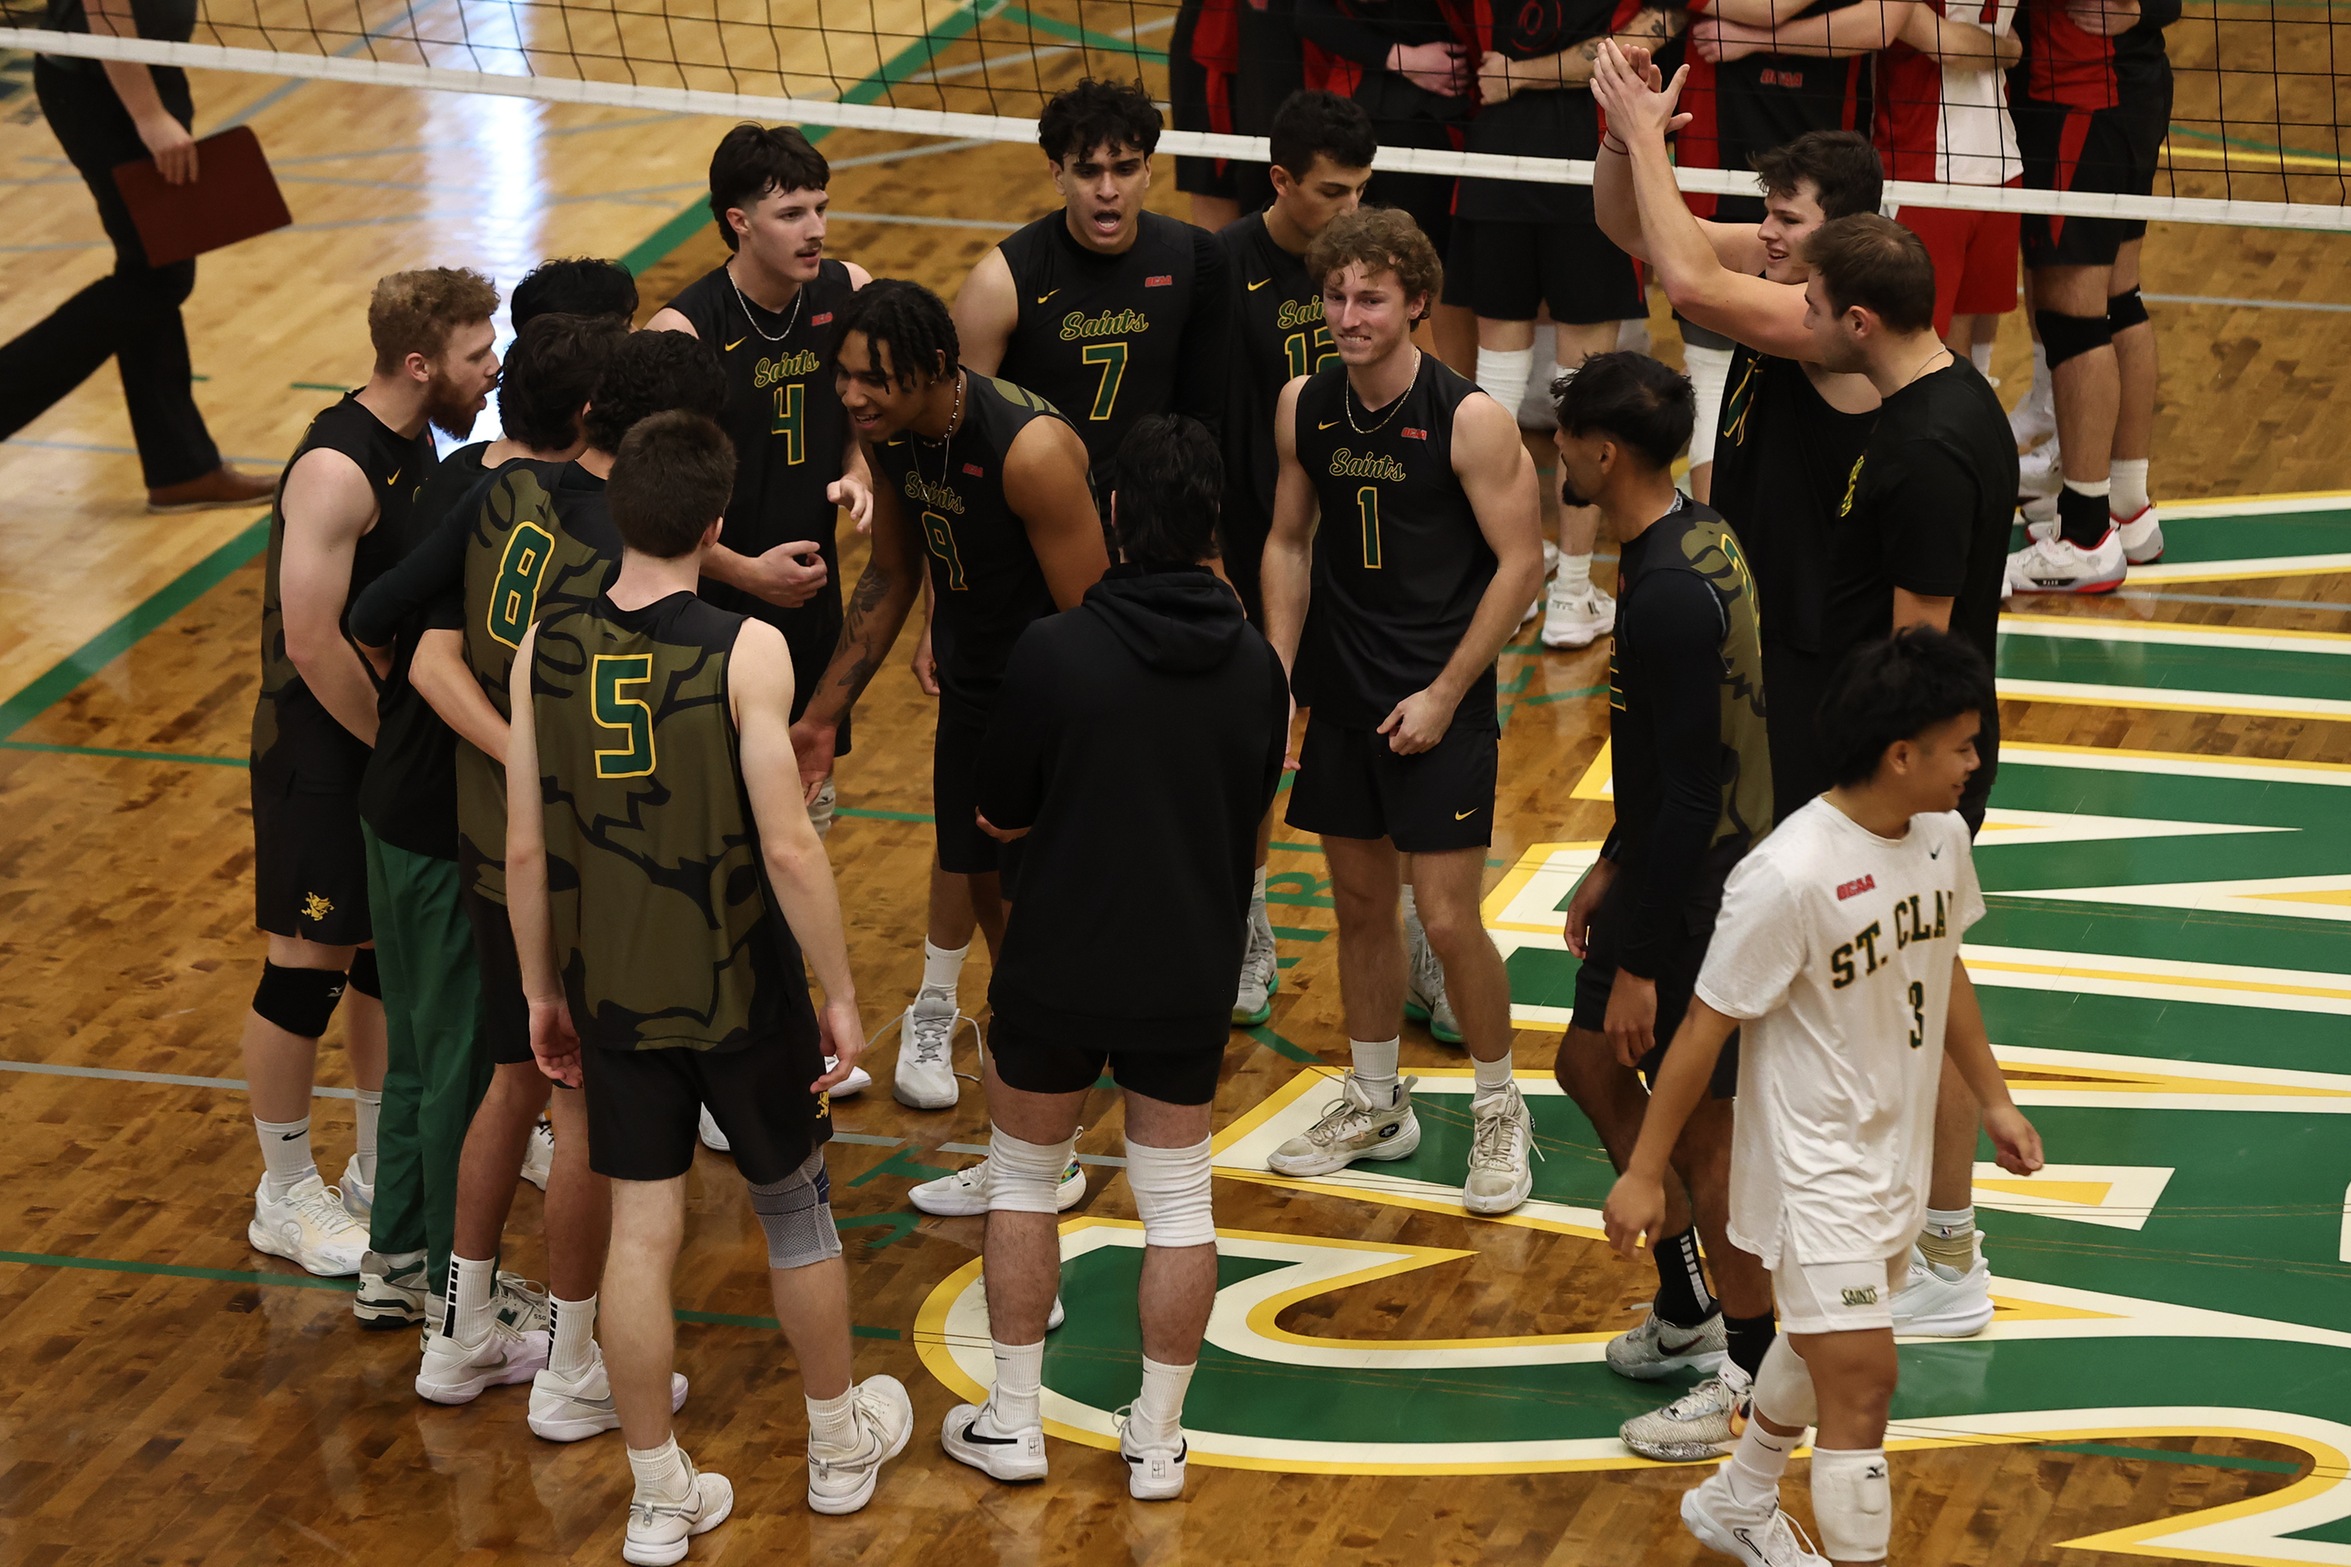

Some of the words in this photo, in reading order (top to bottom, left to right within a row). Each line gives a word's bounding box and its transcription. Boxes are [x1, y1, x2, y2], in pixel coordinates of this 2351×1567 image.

[1059, 309, 1149, 341] Saints
[1277, 295, 1326, 329] Sain
[754, 349, 820, 388] Saints
[1082, 342, 1128, 421] 7
[771, 384, 805, 465] 4
[904, 470, 965, 514] Saints
[1329, 447, 1406, 482] Saints
[921, 511, 968, 591] 9
[1357, 486, 1382, 569] 1
[487, 520, 555, 650] 8
[591, 653, 656, 778] 5
[1830, 919, 1888, 990] ST.
[1894, 889, 1954, 950] CLA
[1909, 980, 1924, 1049] 3
